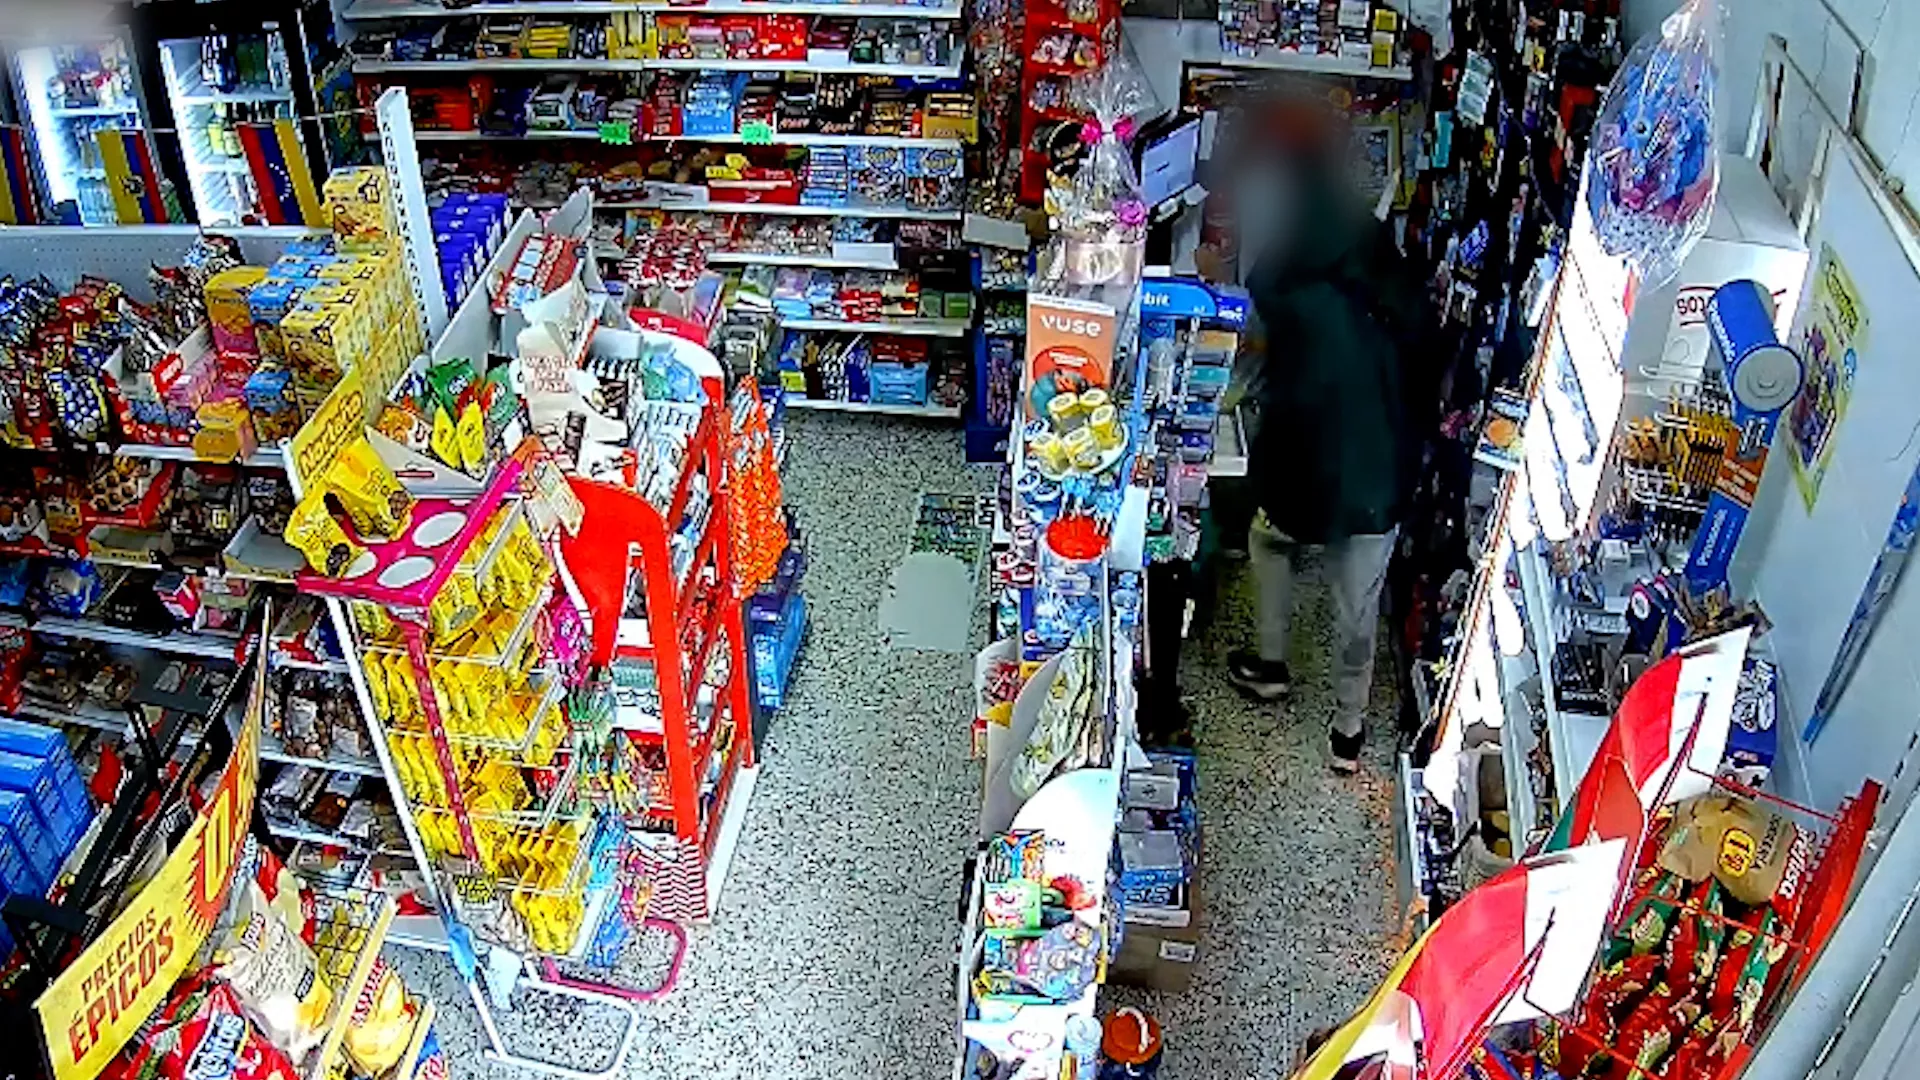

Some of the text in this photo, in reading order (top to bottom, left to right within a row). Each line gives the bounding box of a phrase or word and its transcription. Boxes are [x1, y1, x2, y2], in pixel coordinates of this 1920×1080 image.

[1040, 314, 1102, 337] vuse
[1142, 291, 1170, 306] bit
[80, 907, 157, 1003] PRECIOS
[67, 917, 175, 1066] ÉPICOS
